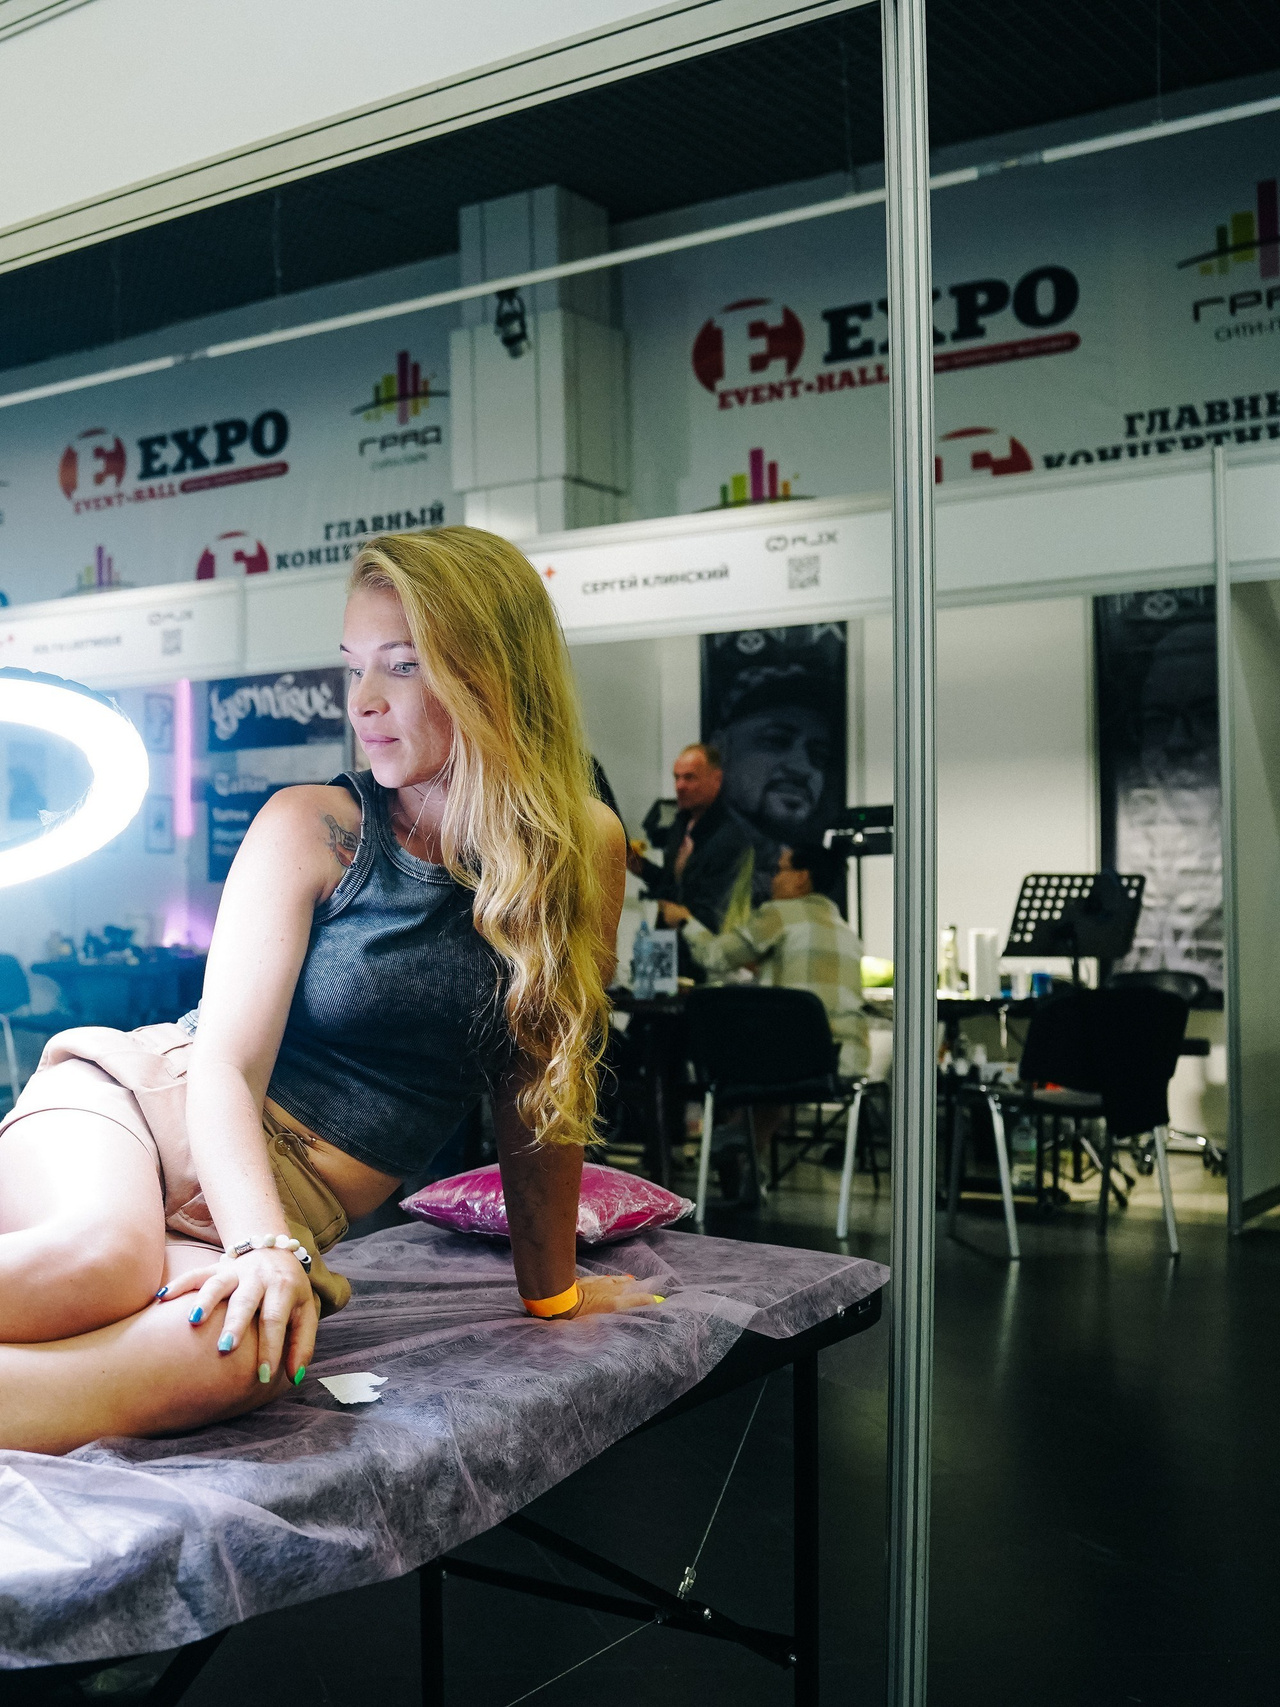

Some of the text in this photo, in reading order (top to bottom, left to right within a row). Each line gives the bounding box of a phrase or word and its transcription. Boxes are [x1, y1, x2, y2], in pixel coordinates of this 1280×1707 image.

[137, 409, 290, 482] EXPO
[324, 500, 444, 541] ГЛАВНЫЙ
[581, 562, 730, 595] СЕРГЕЙ КЛИНСКИЙ
